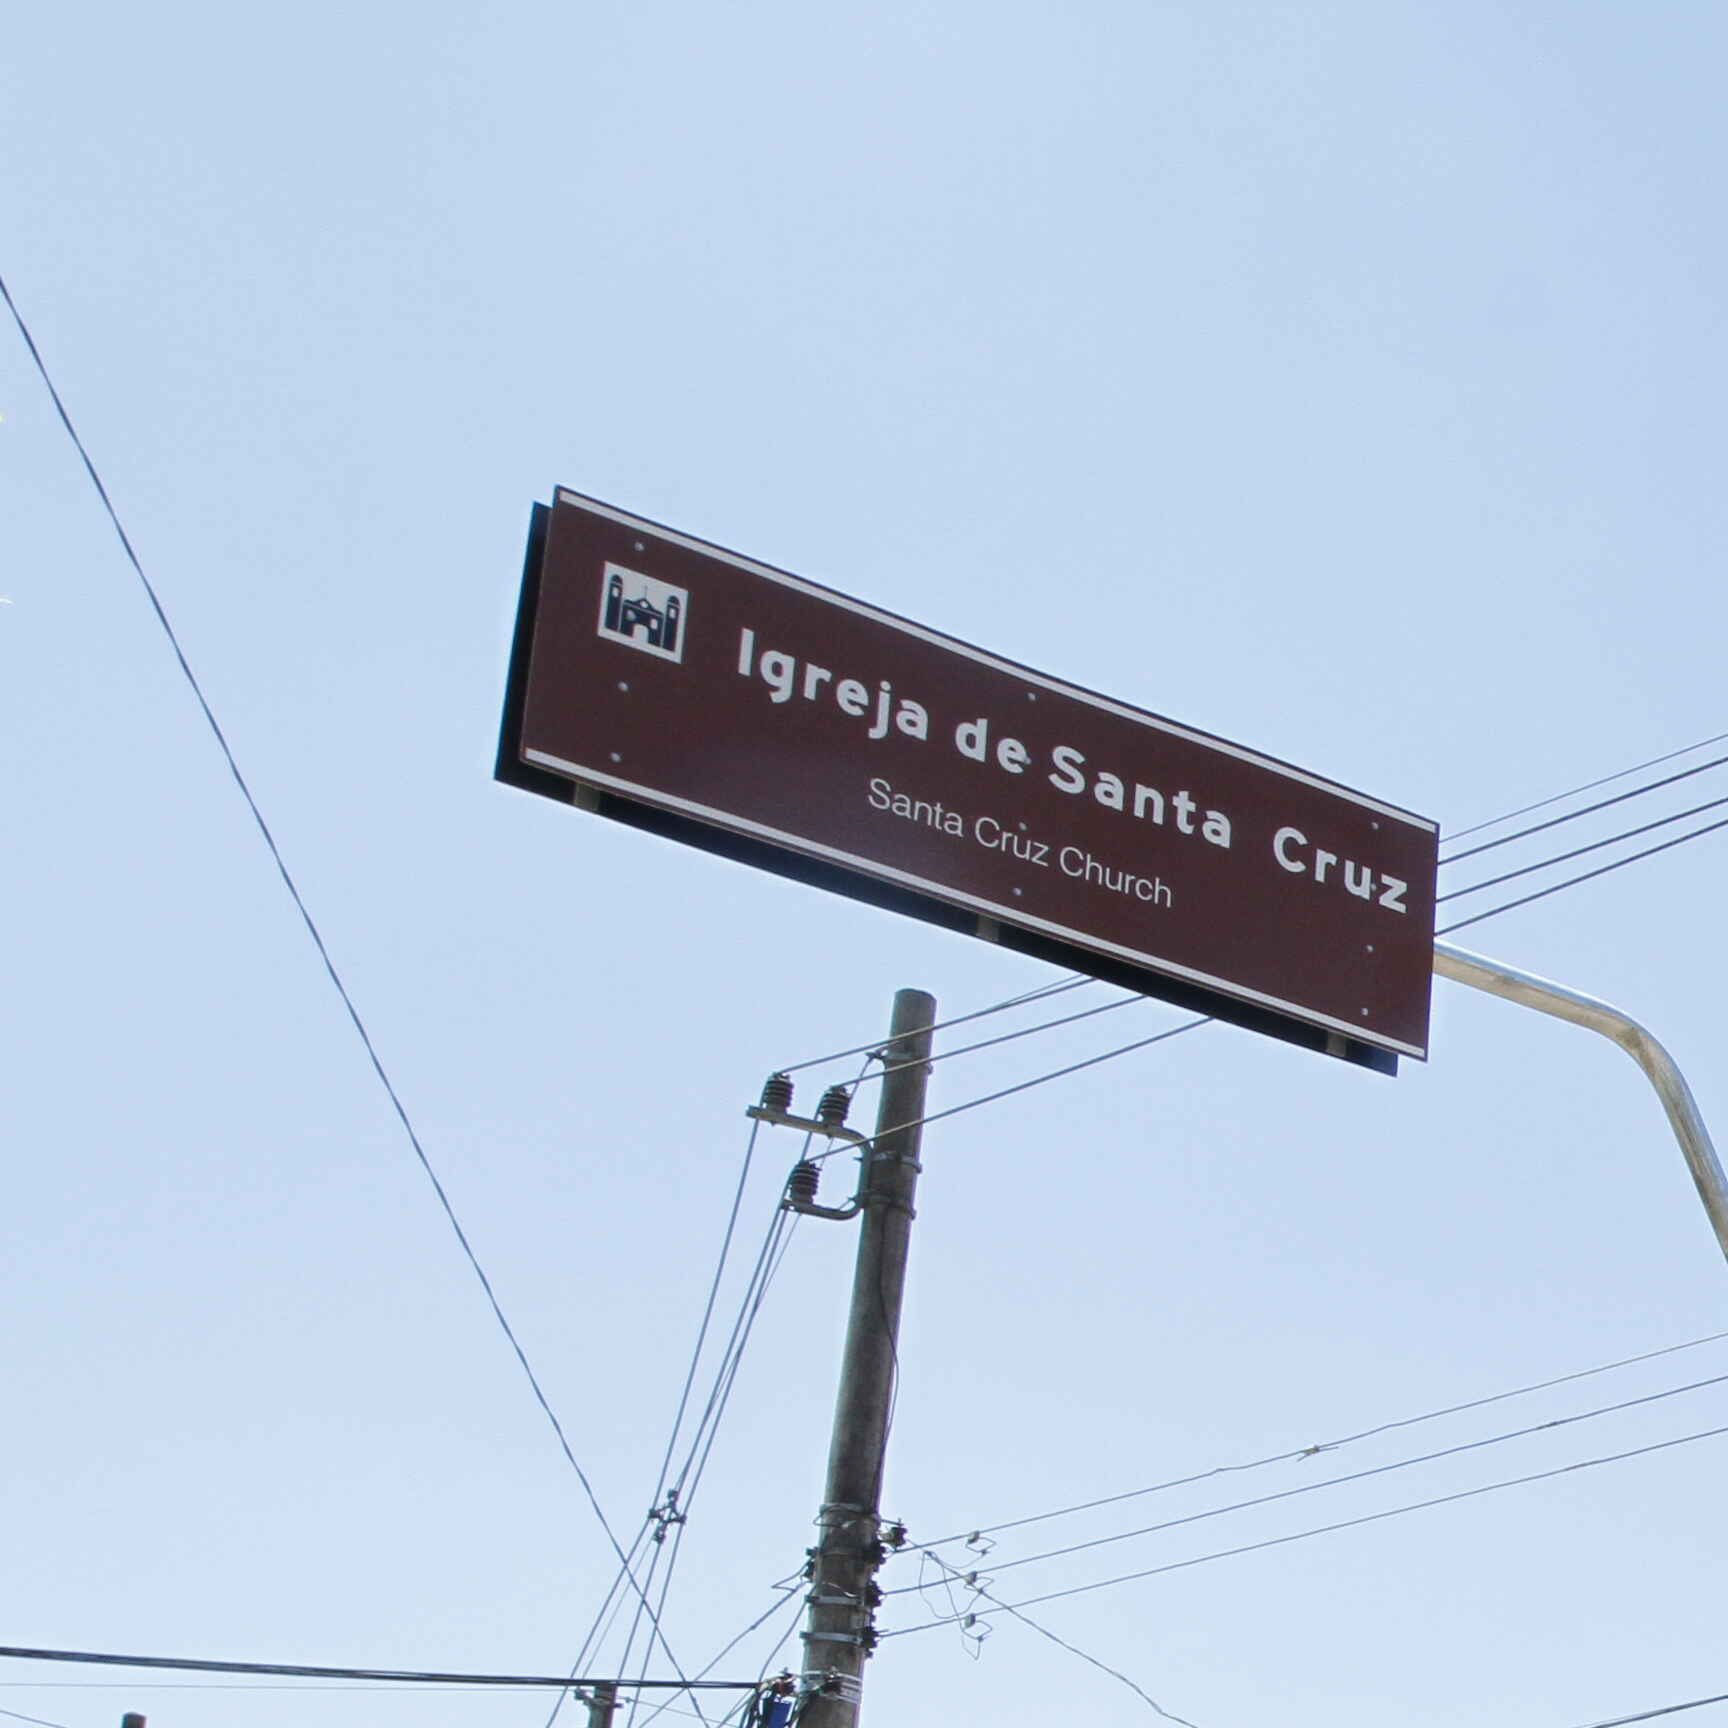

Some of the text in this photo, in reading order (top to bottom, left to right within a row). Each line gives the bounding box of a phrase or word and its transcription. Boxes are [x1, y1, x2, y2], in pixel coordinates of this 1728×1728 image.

[738, 628, 1409, 914] Igreja de Santa Cruz
[867, 777, 1174, 908] Santa Cruz Church
